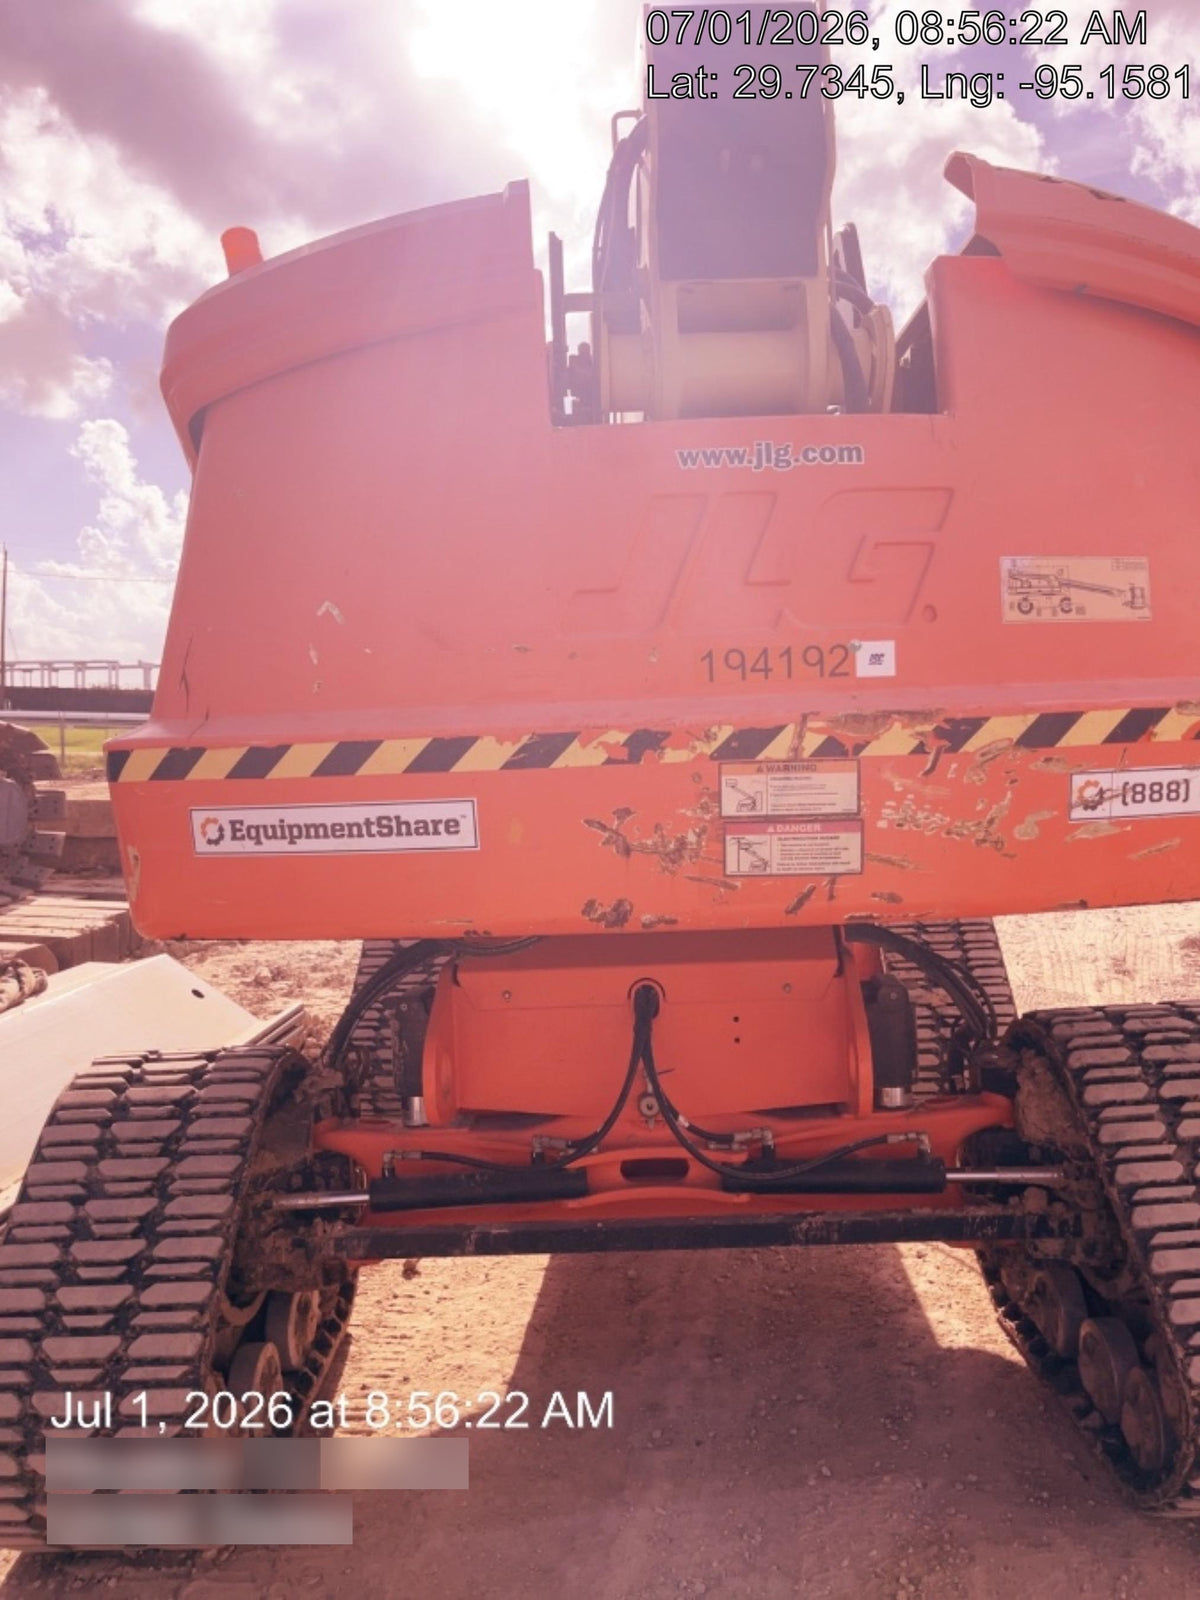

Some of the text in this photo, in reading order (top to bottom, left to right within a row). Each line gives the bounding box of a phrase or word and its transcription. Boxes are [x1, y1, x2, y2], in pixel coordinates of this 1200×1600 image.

[676, 442, 865, 471] www.jlg.com
[700, 643, 851, 682] 194192
[766, 763, 817, 773] WARNING
[1121, 778, 1190, 806] (888)
[228, 814, 460, 846] EquipmentShare
[776, 823, 821, 833] DANGER
